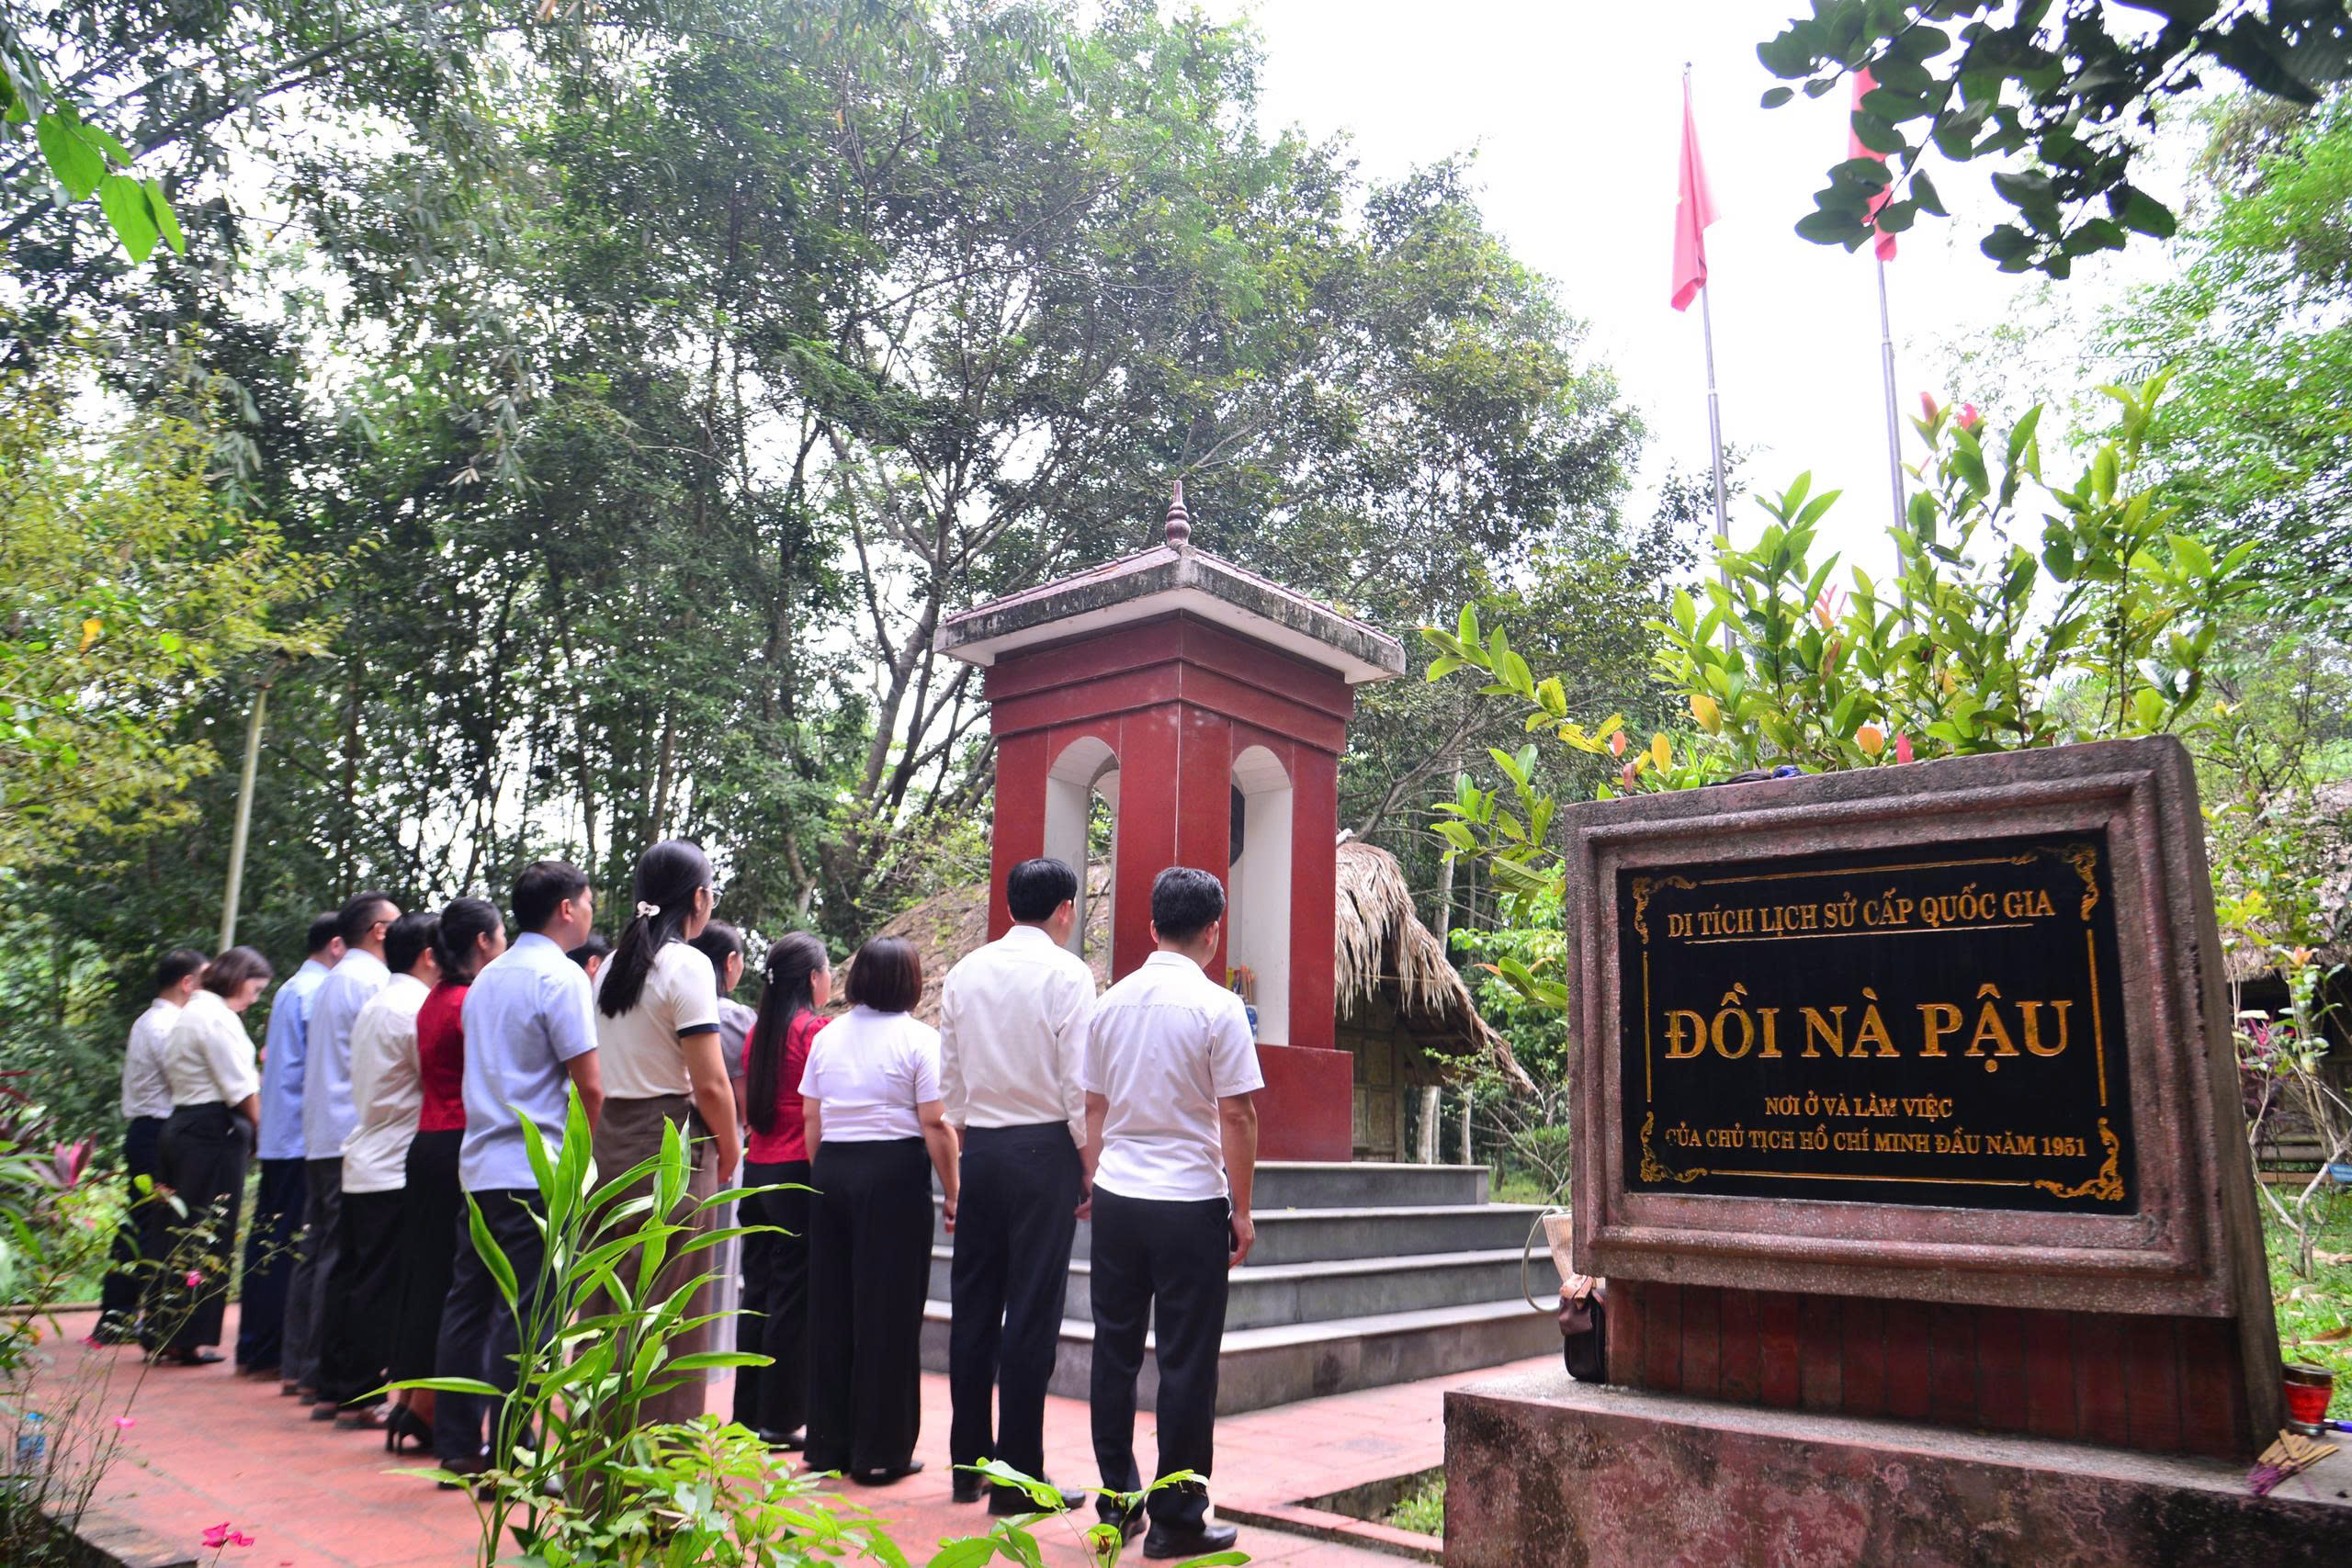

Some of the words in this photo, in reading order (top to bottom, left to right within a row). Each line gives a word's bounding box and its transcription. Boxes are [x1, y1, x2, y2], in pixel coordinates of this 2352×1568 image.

[1668, 913, 1693, 937] DI
[1698, 904, 1754, 936] TÍCH
[1759, 904, 1818, 937] LỊCH
[1823, 891, 1858, 928] SỬ
[1863, 887, 1914, 926] CẤP
[1920, 882, 1996, 928] QUỐC
[2003, 889, 2056, 919] GIA
[1664, 982, 1781, 1059] ĐỒI
[1800, 987, 1900, 1058] NÀ
[1917, 983, 2074, 1073] PẬU
[1764, 1095, 1800, 1116] NƠI
[1804, 1089, 1818, 1116] Ở
[1822, 1093, 1850, 1117] VÀ
[1853, 1091, 1898, 1117] LÀM
[1901, 1093, 1953, 1122] VIỆC
[1665, 1120, 1702, 1146] CỦA
[1705, 1122, 1745, 1147] CHỦ
[1748, 1130, 1794, 1153] TỊCH
[1799, 1122, 1828, 1150] HỒ
[1833, 1127, 1870, 1151] CHÍ
[1874, 1133, 1929, 1153] MINH
[1934, 1126, 1980, 1154] ĐẦU
[1985, 1131, 2037, 1156] NĂM
[2041, 1136, 2087, 1156] 1951
